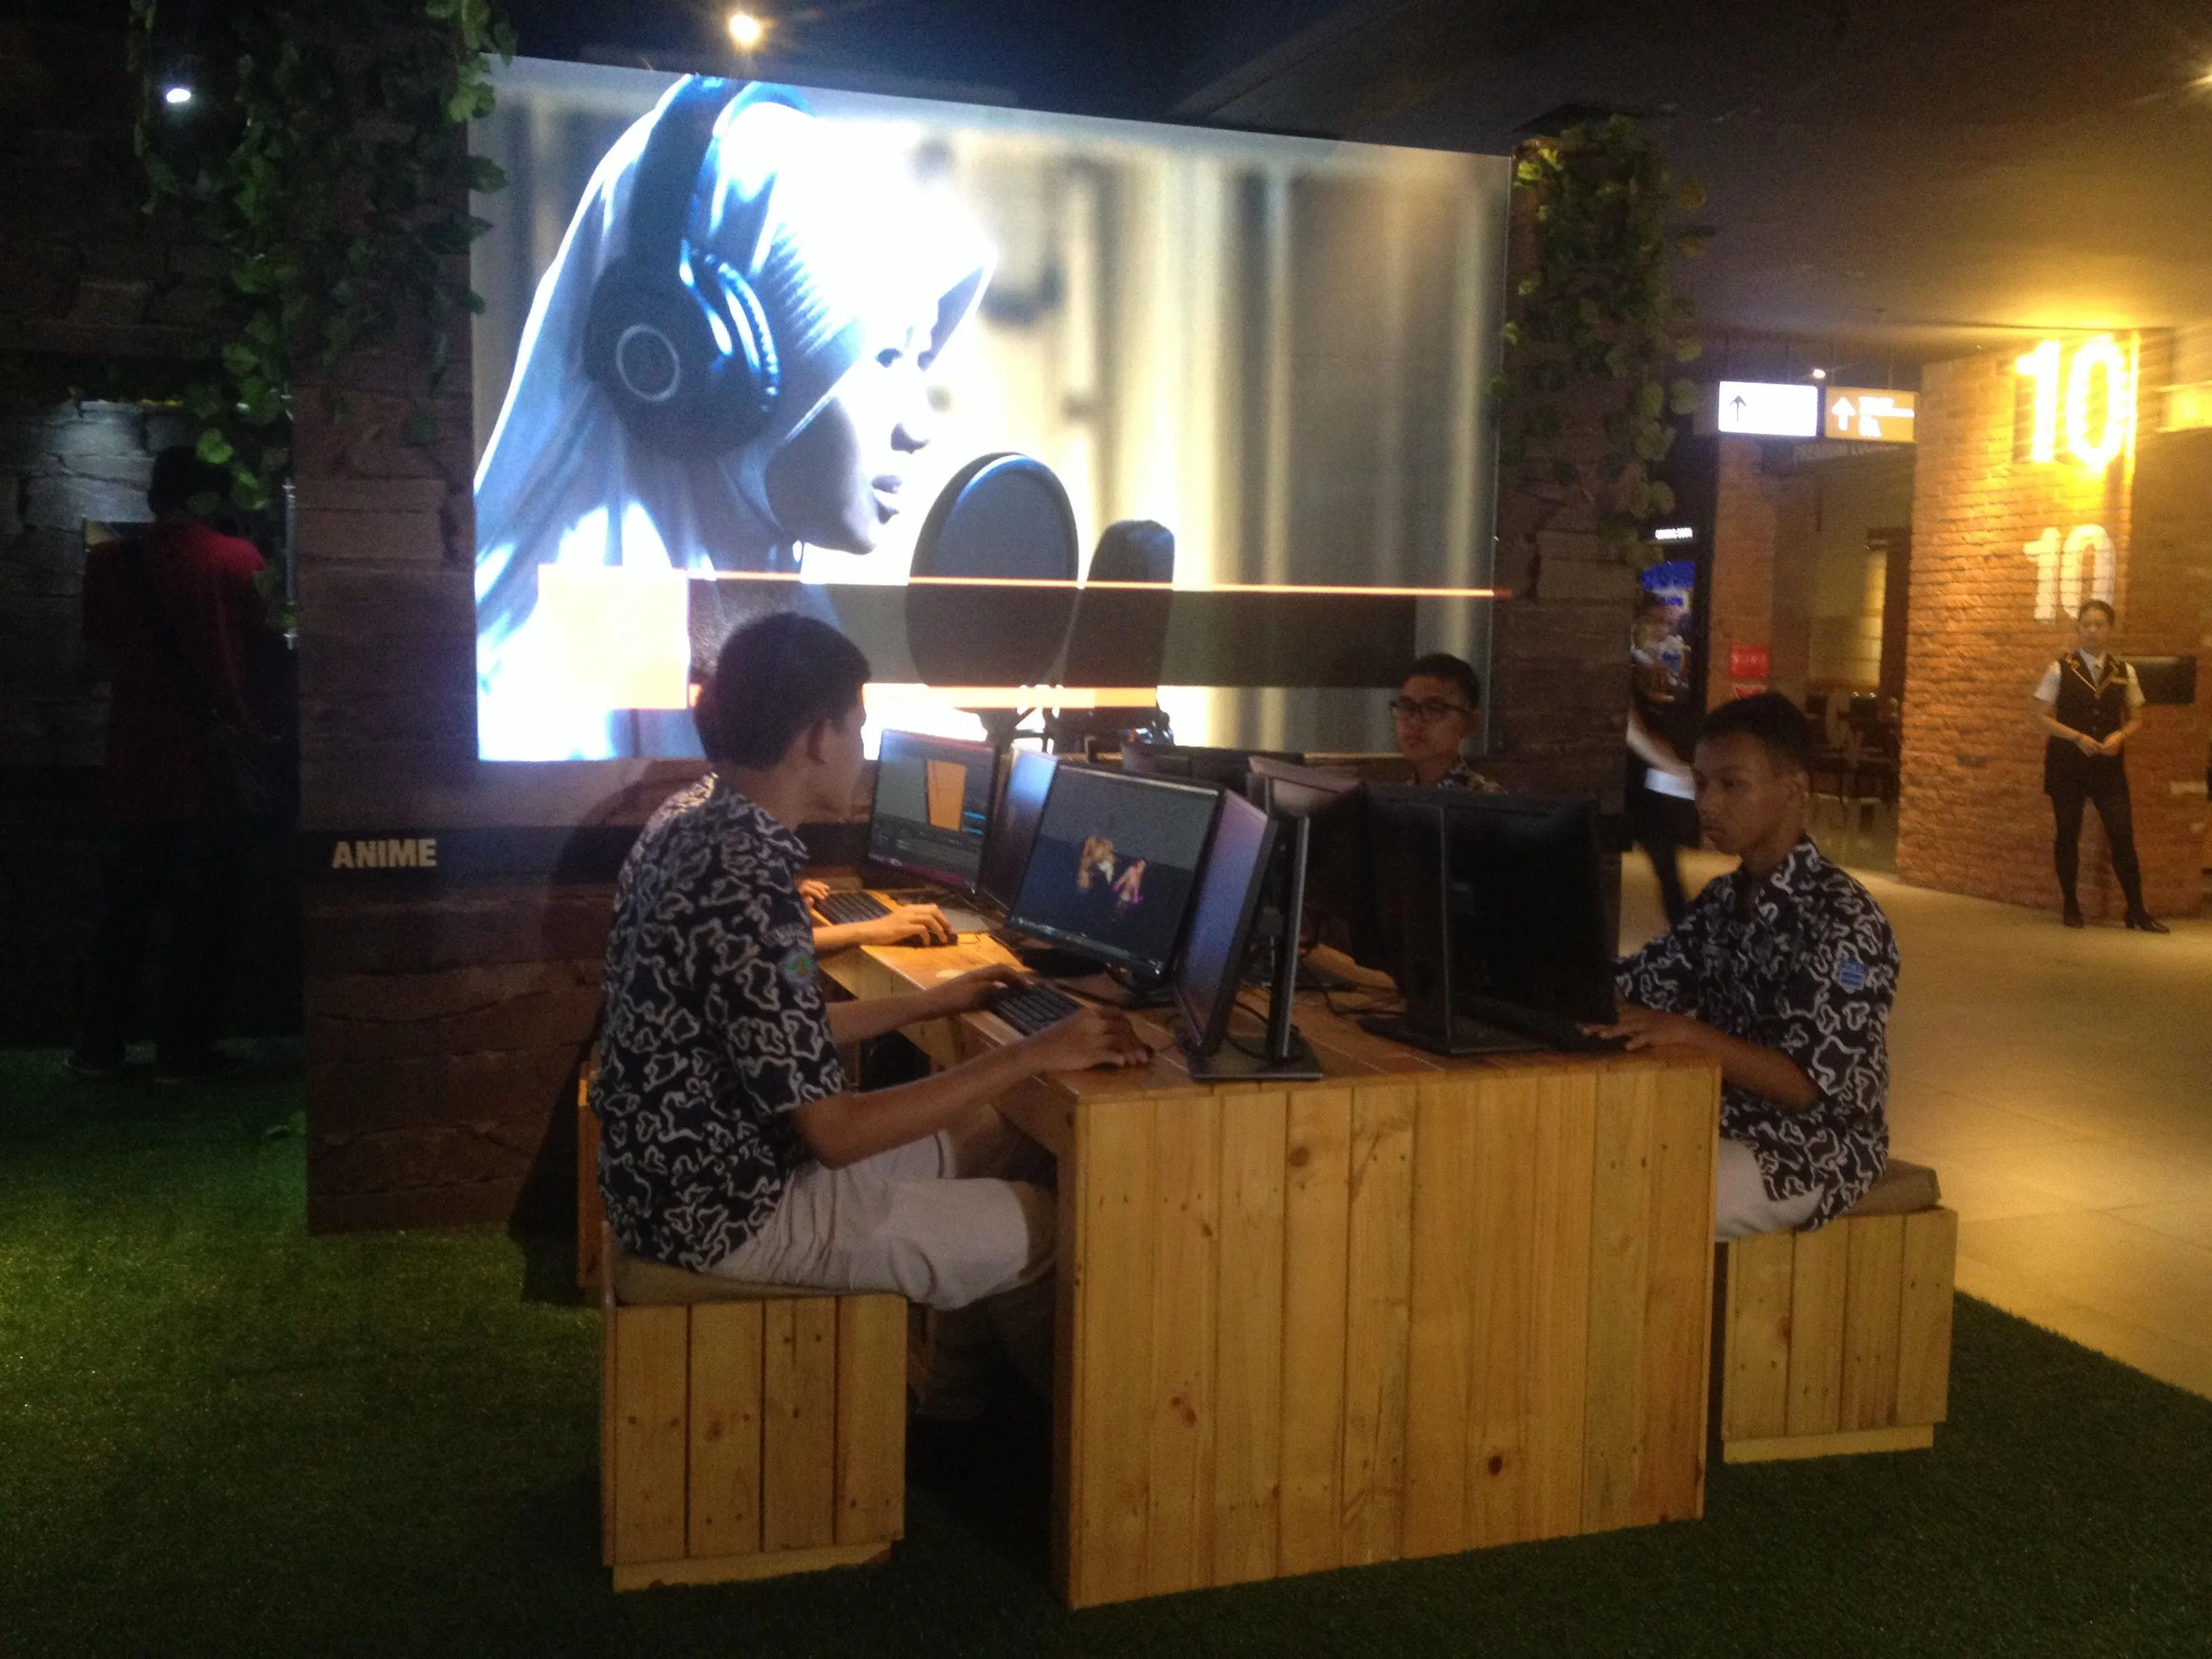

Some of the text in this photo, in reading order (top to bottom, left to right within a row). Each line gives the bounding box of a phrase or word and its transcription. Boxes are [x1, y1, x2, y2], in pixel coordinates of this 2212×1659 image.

[2014, 337, 2127, 472] 10
[2024, 525, 2117, 625] 10
[331, 838, 437, 868] ANIME
